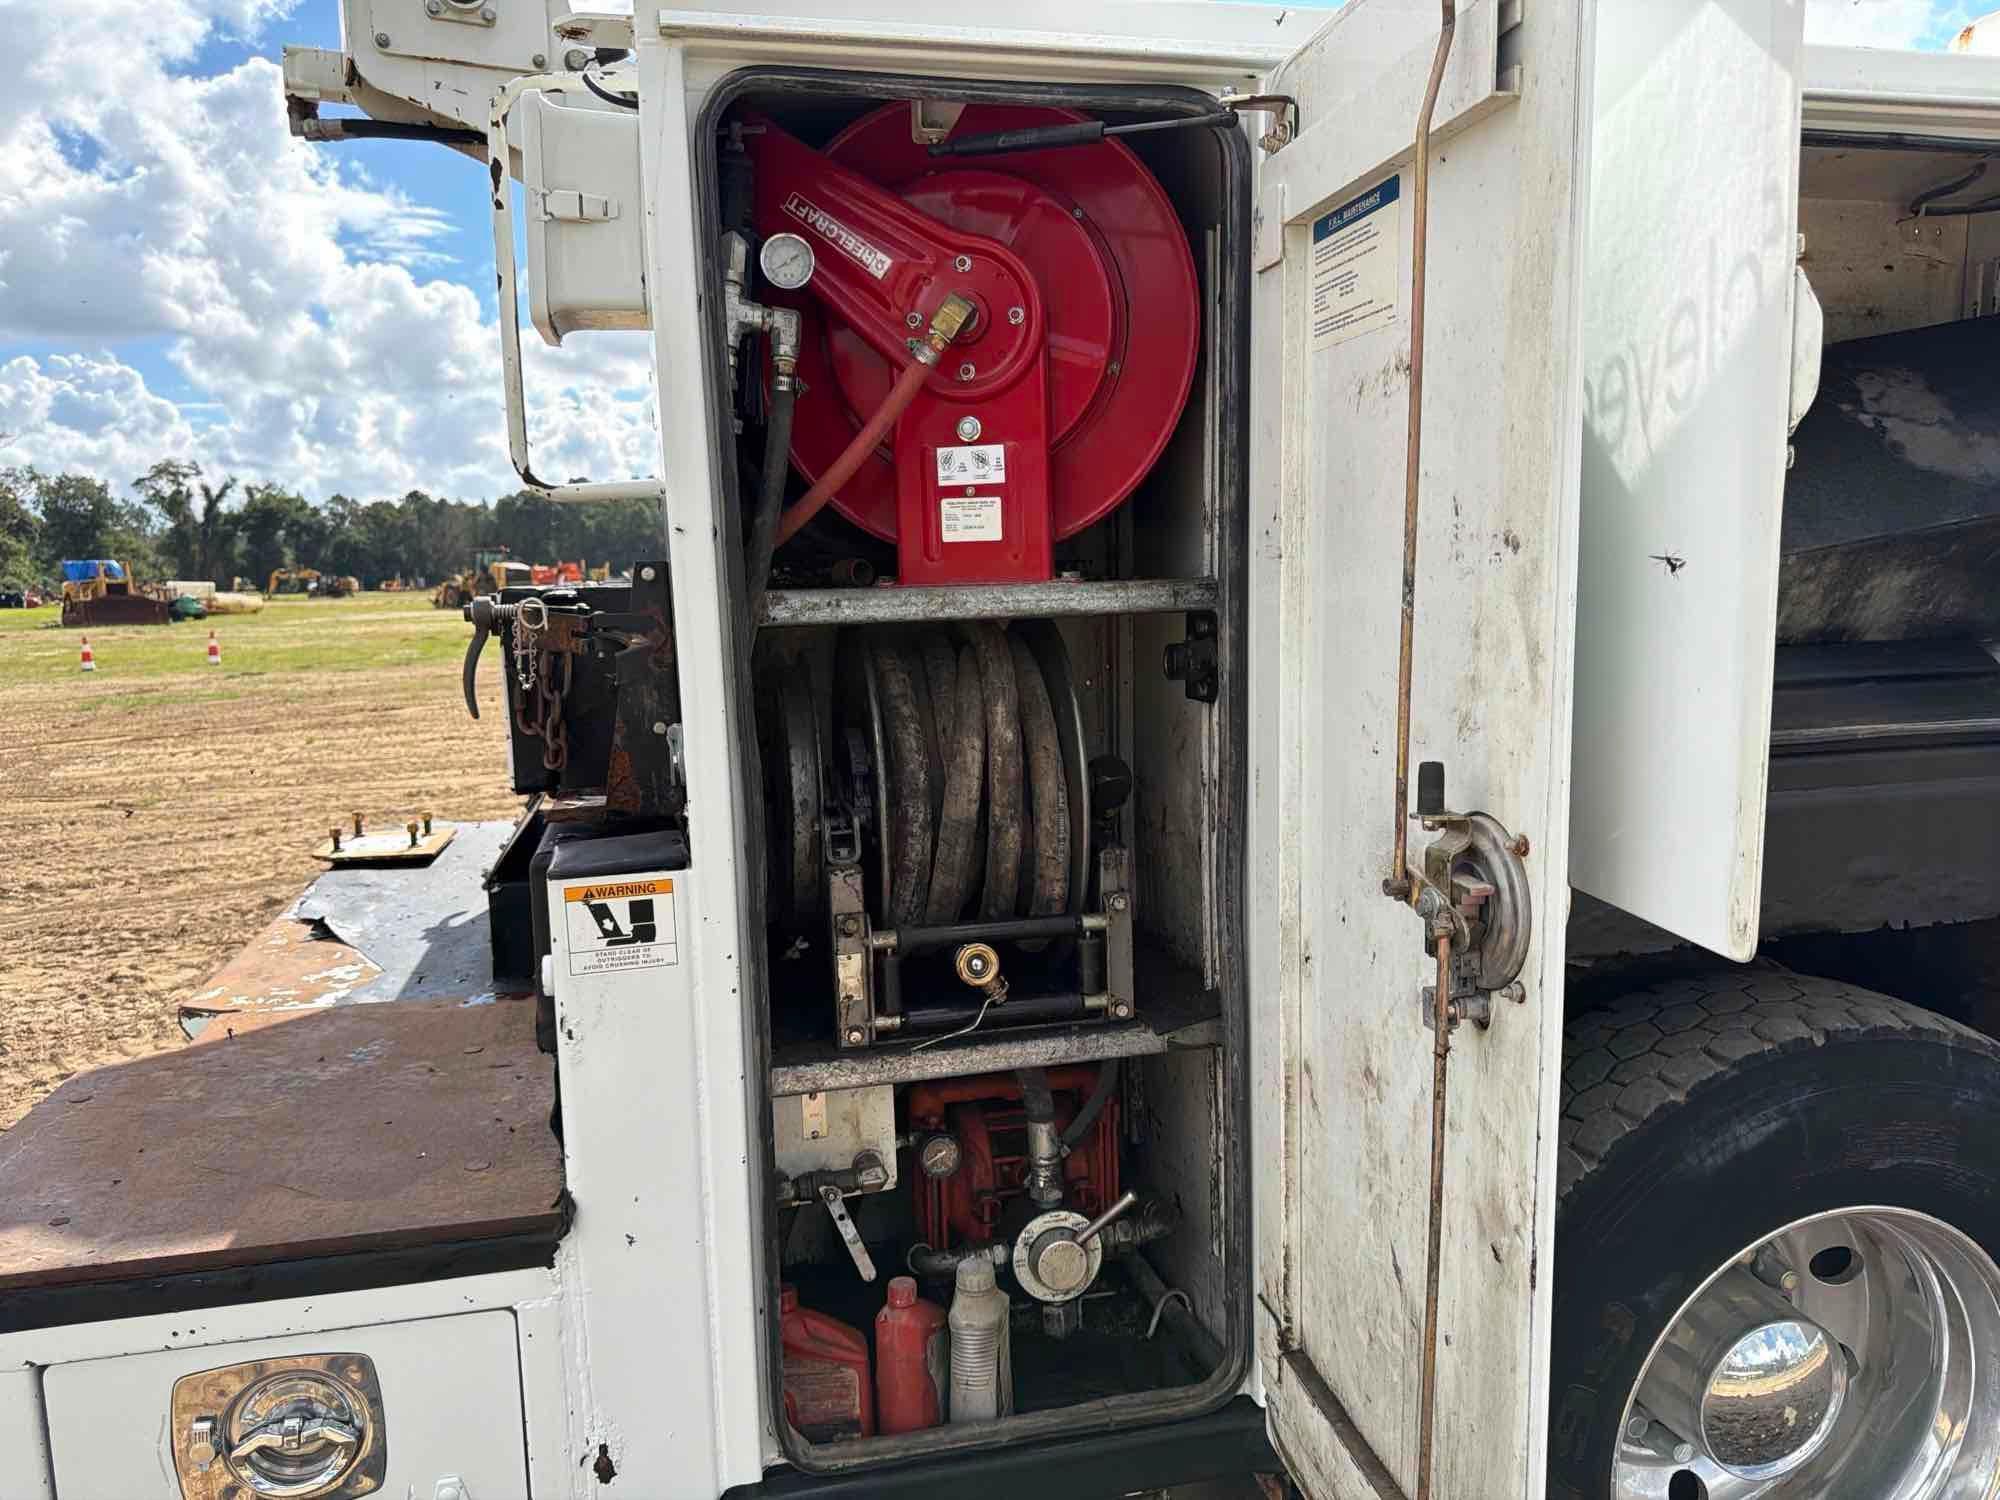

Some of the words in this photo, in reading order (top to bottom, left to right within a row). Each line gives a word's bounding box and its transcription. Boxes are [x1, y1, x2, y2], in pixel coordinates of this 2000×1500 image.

[1343, 191, 1381, 218] MAINTENANCE
[785, 197, 878, 267] REELCRAFT
[595, 883, 657, 897] WARNING
